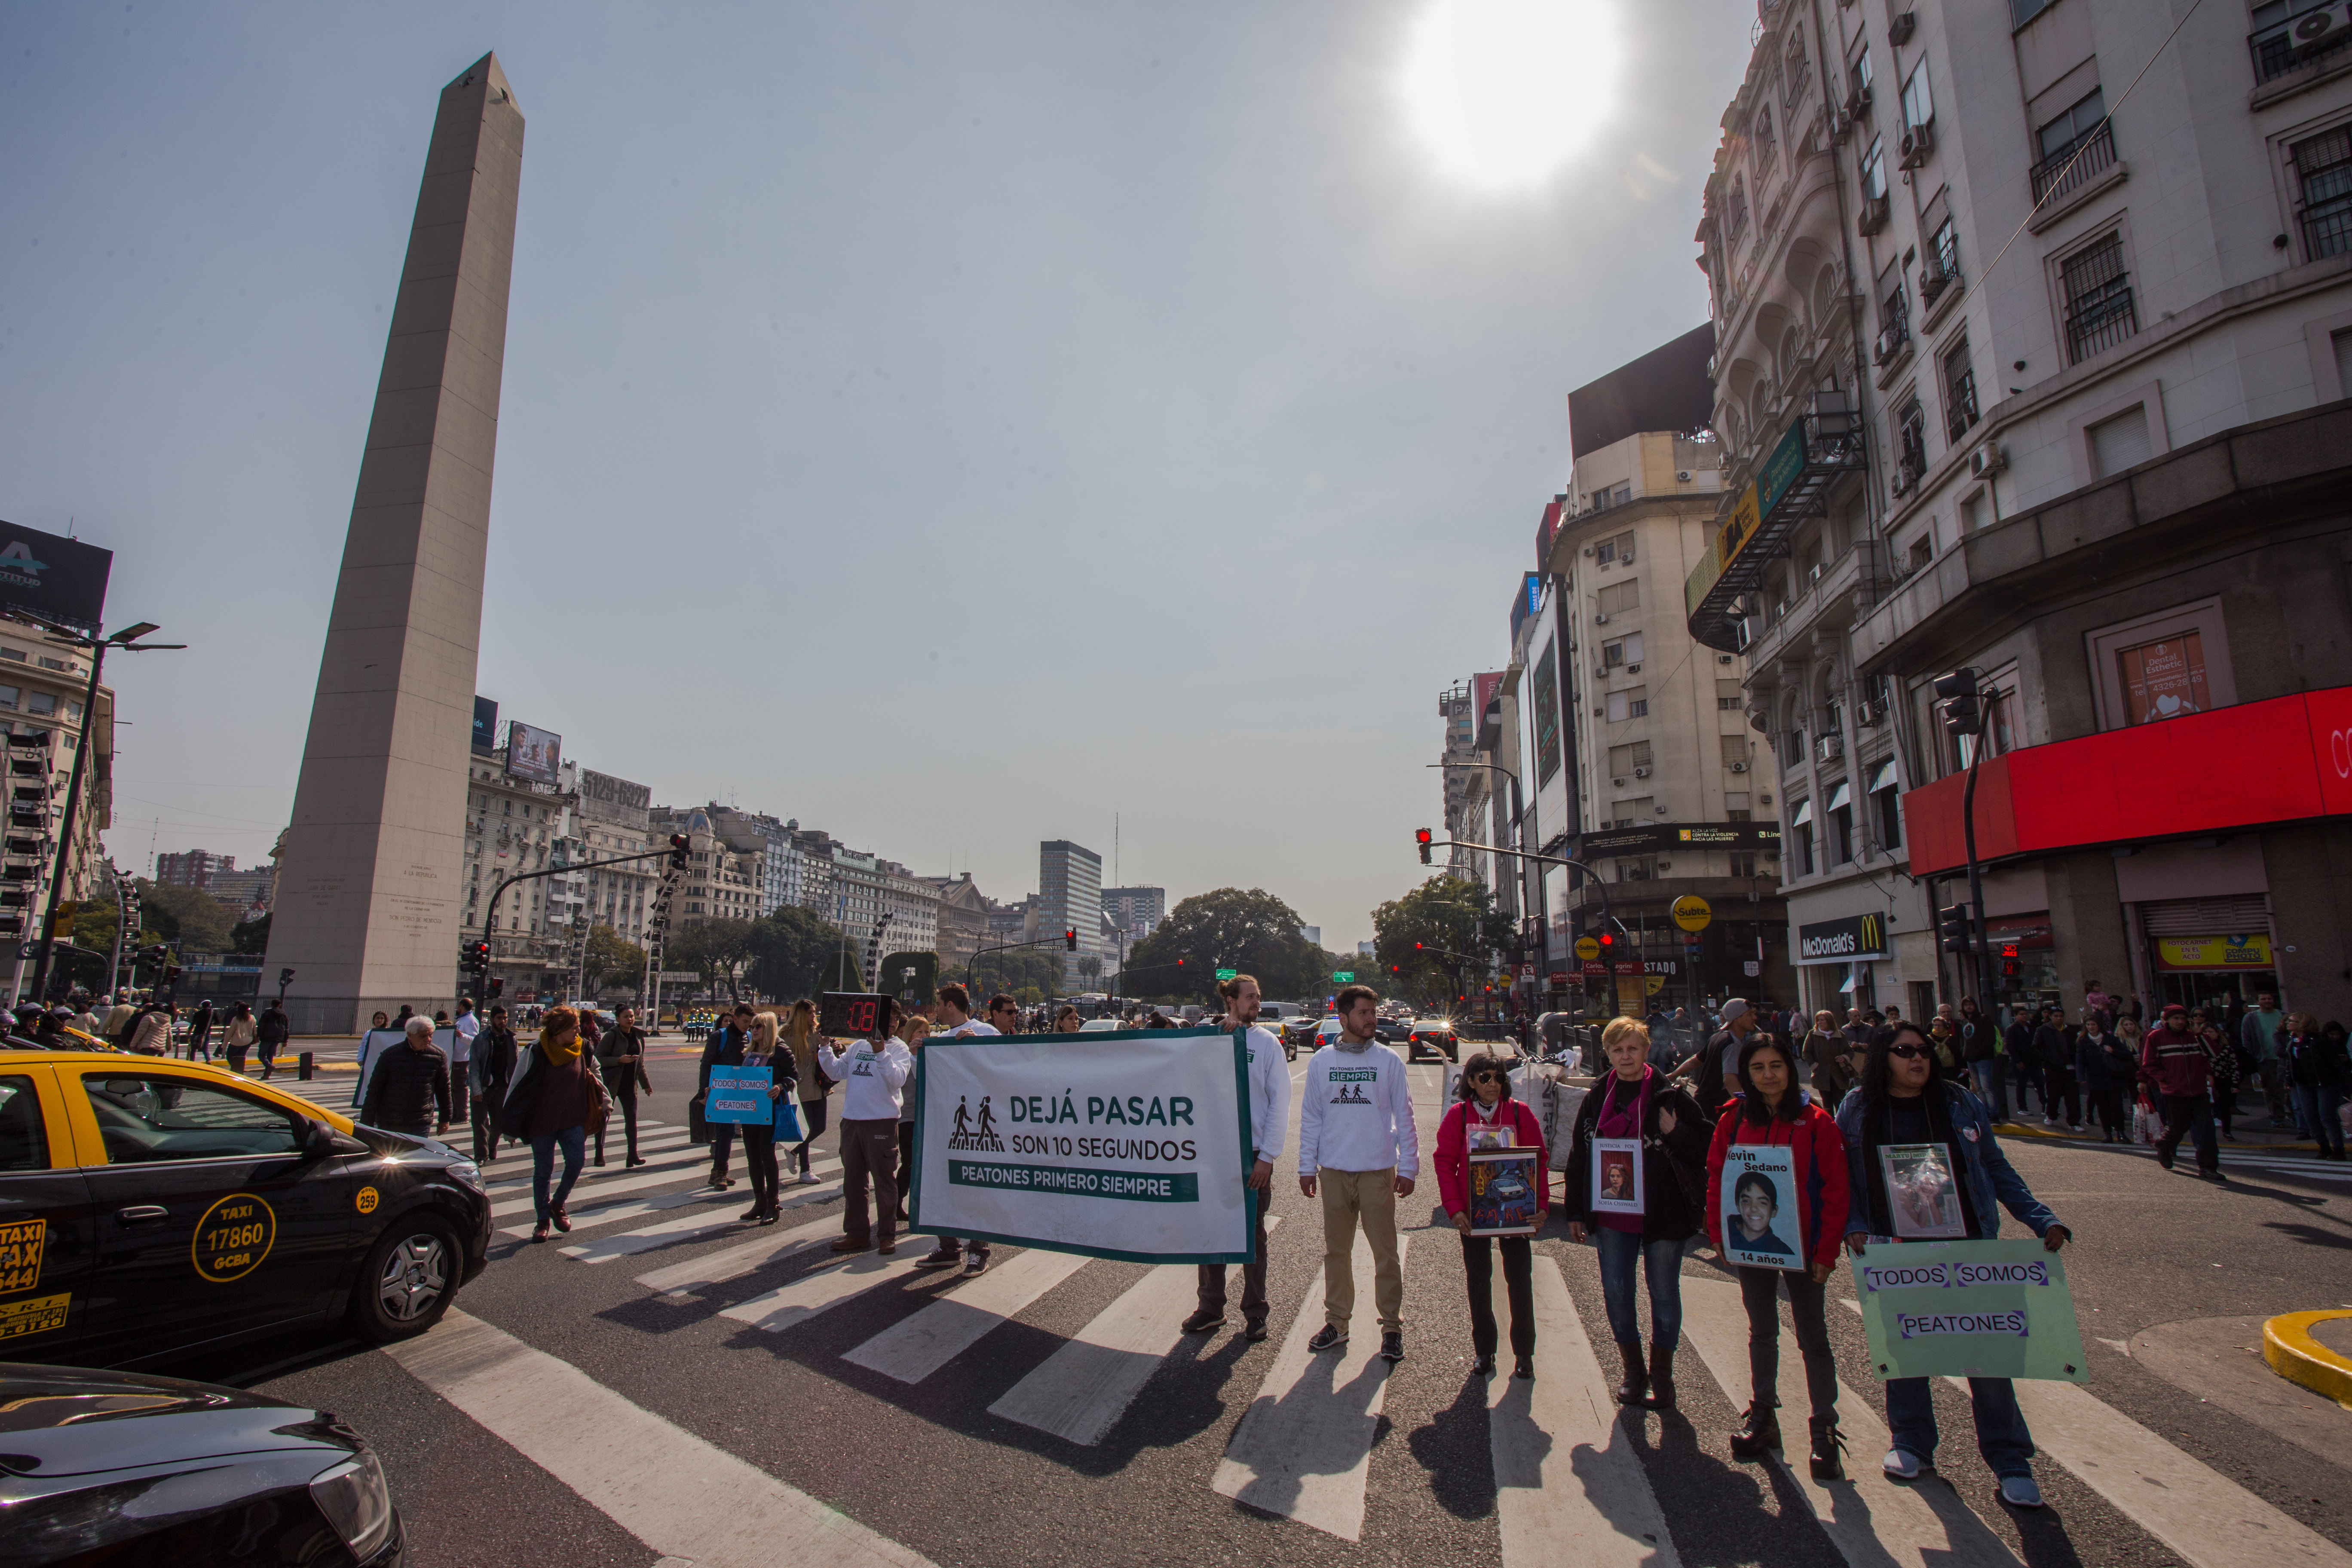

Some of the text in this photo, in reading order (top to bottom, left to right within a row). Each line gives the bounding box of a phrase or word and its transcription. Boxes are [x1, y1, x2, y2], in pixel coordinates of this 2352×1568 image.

[2146, 660, 2183, 674] Esthetic
[2149, 653, 2177, 666] Dental
[583, 771, 650, 812] 5129-6322
[853, 853, 867, 862] HOTELS
[1678, 907, 1706, 916] Subte
[1802, 932, 1855, 956] McDonald's
[1331, 1072, 1375, 1081] SIEMPRE
[719, 1101, 755, 1109] PEATONES
[1010, 1087, 1194, 1126] DEJÁ PASAR
[1013, 1135, 1197, 1161] SON 10 SEGUNDOS
[1744, 1162, 1787, 1172] Sedano
[962, 1165, 1172, 1197] PEATONES PRIMERO SIEMPRE
[360, 1195, 376, 1209] 259
[220, 1205, 253, 1220] TAXI
[0, 1224, 42, 1244] TAXI
[208, 1222, 263, 1251] 17860
[214, 1253, 251, 1270] GCBA
[1740, 1252, 1785, 1265] 14 años
[1870, 1265, 2043, 1285] TODOS SOMOS
[7, 1311, 42, 1323] MATRICULA
[1904, 1314, 2022, 1333] PEATONES
